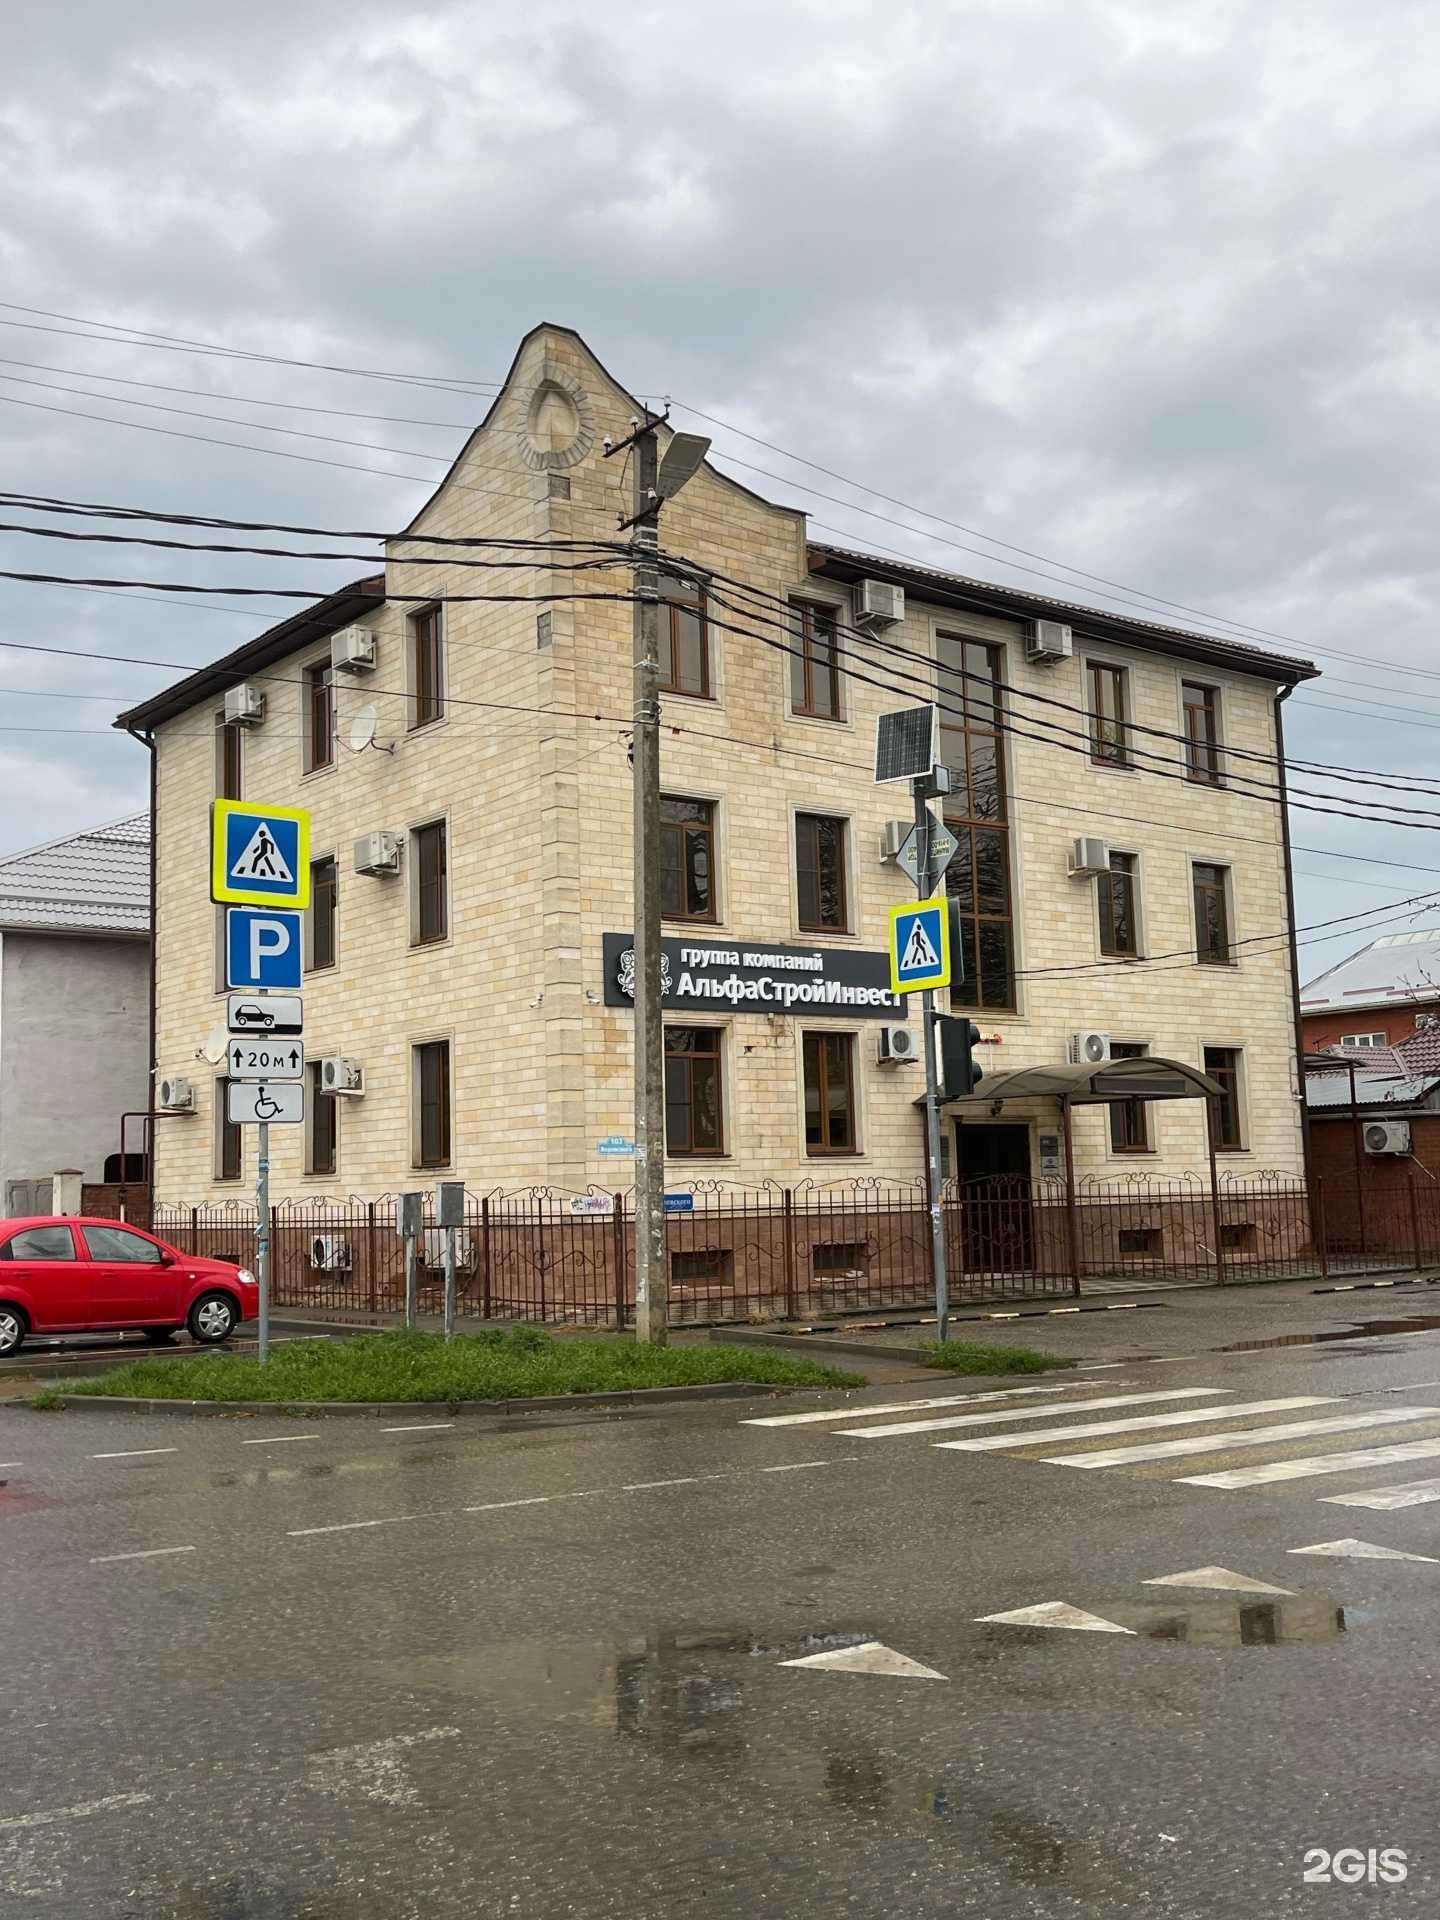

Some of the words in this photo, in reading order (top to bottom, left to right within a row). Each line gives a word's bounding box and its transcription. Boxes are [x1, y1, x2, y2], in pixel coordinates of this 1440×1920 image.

[250, 918, 290, 980] P
[680, 948, 740, 969] группа
[742, 952, 824, 972] компаний
